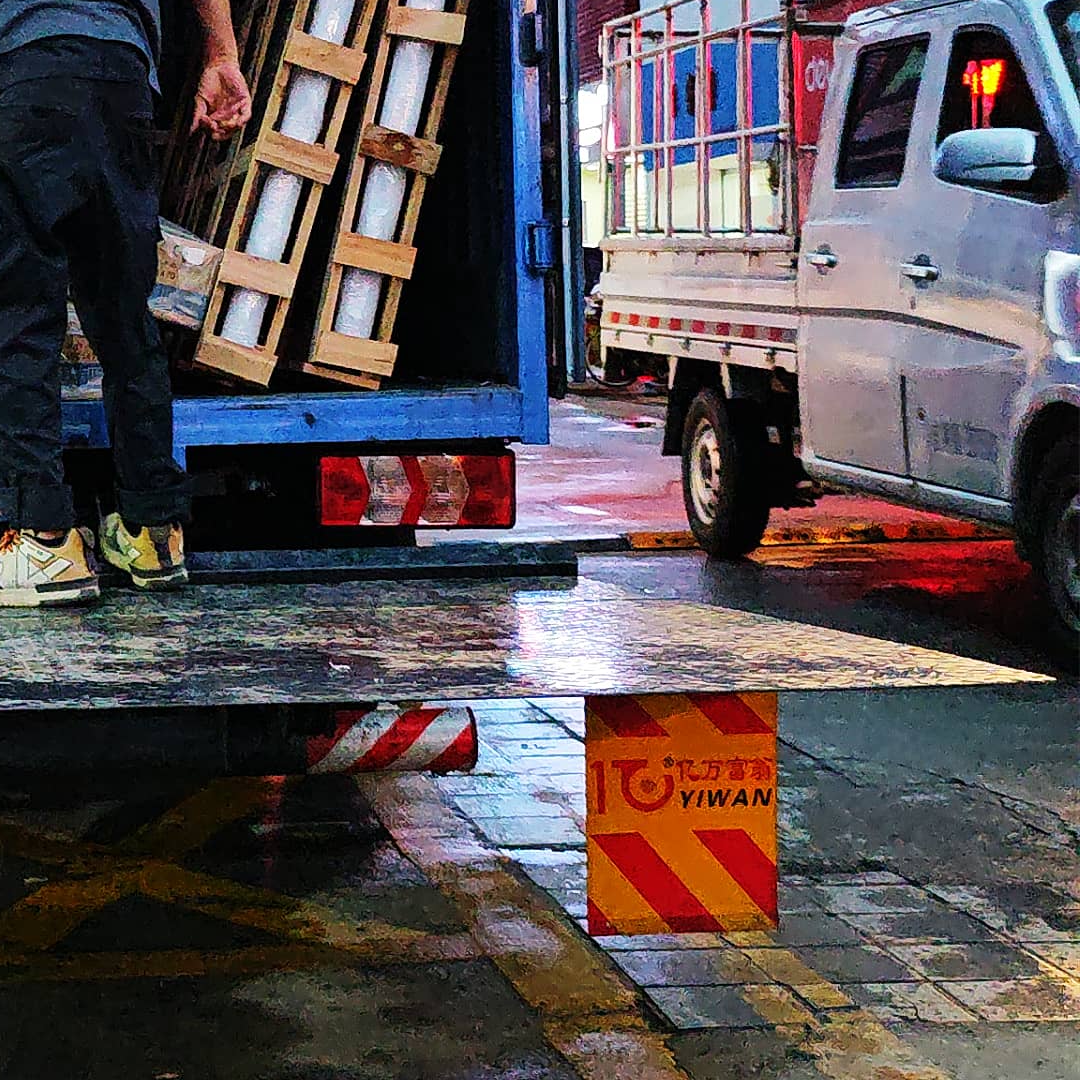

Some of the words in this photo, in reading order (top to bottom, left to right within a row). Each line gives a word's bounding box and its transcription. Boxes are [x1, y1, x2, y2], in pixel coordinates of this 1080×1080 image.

[676, 757, 772, 782] 亿万富翁
[680, 787, 773, 809] YIWAN
